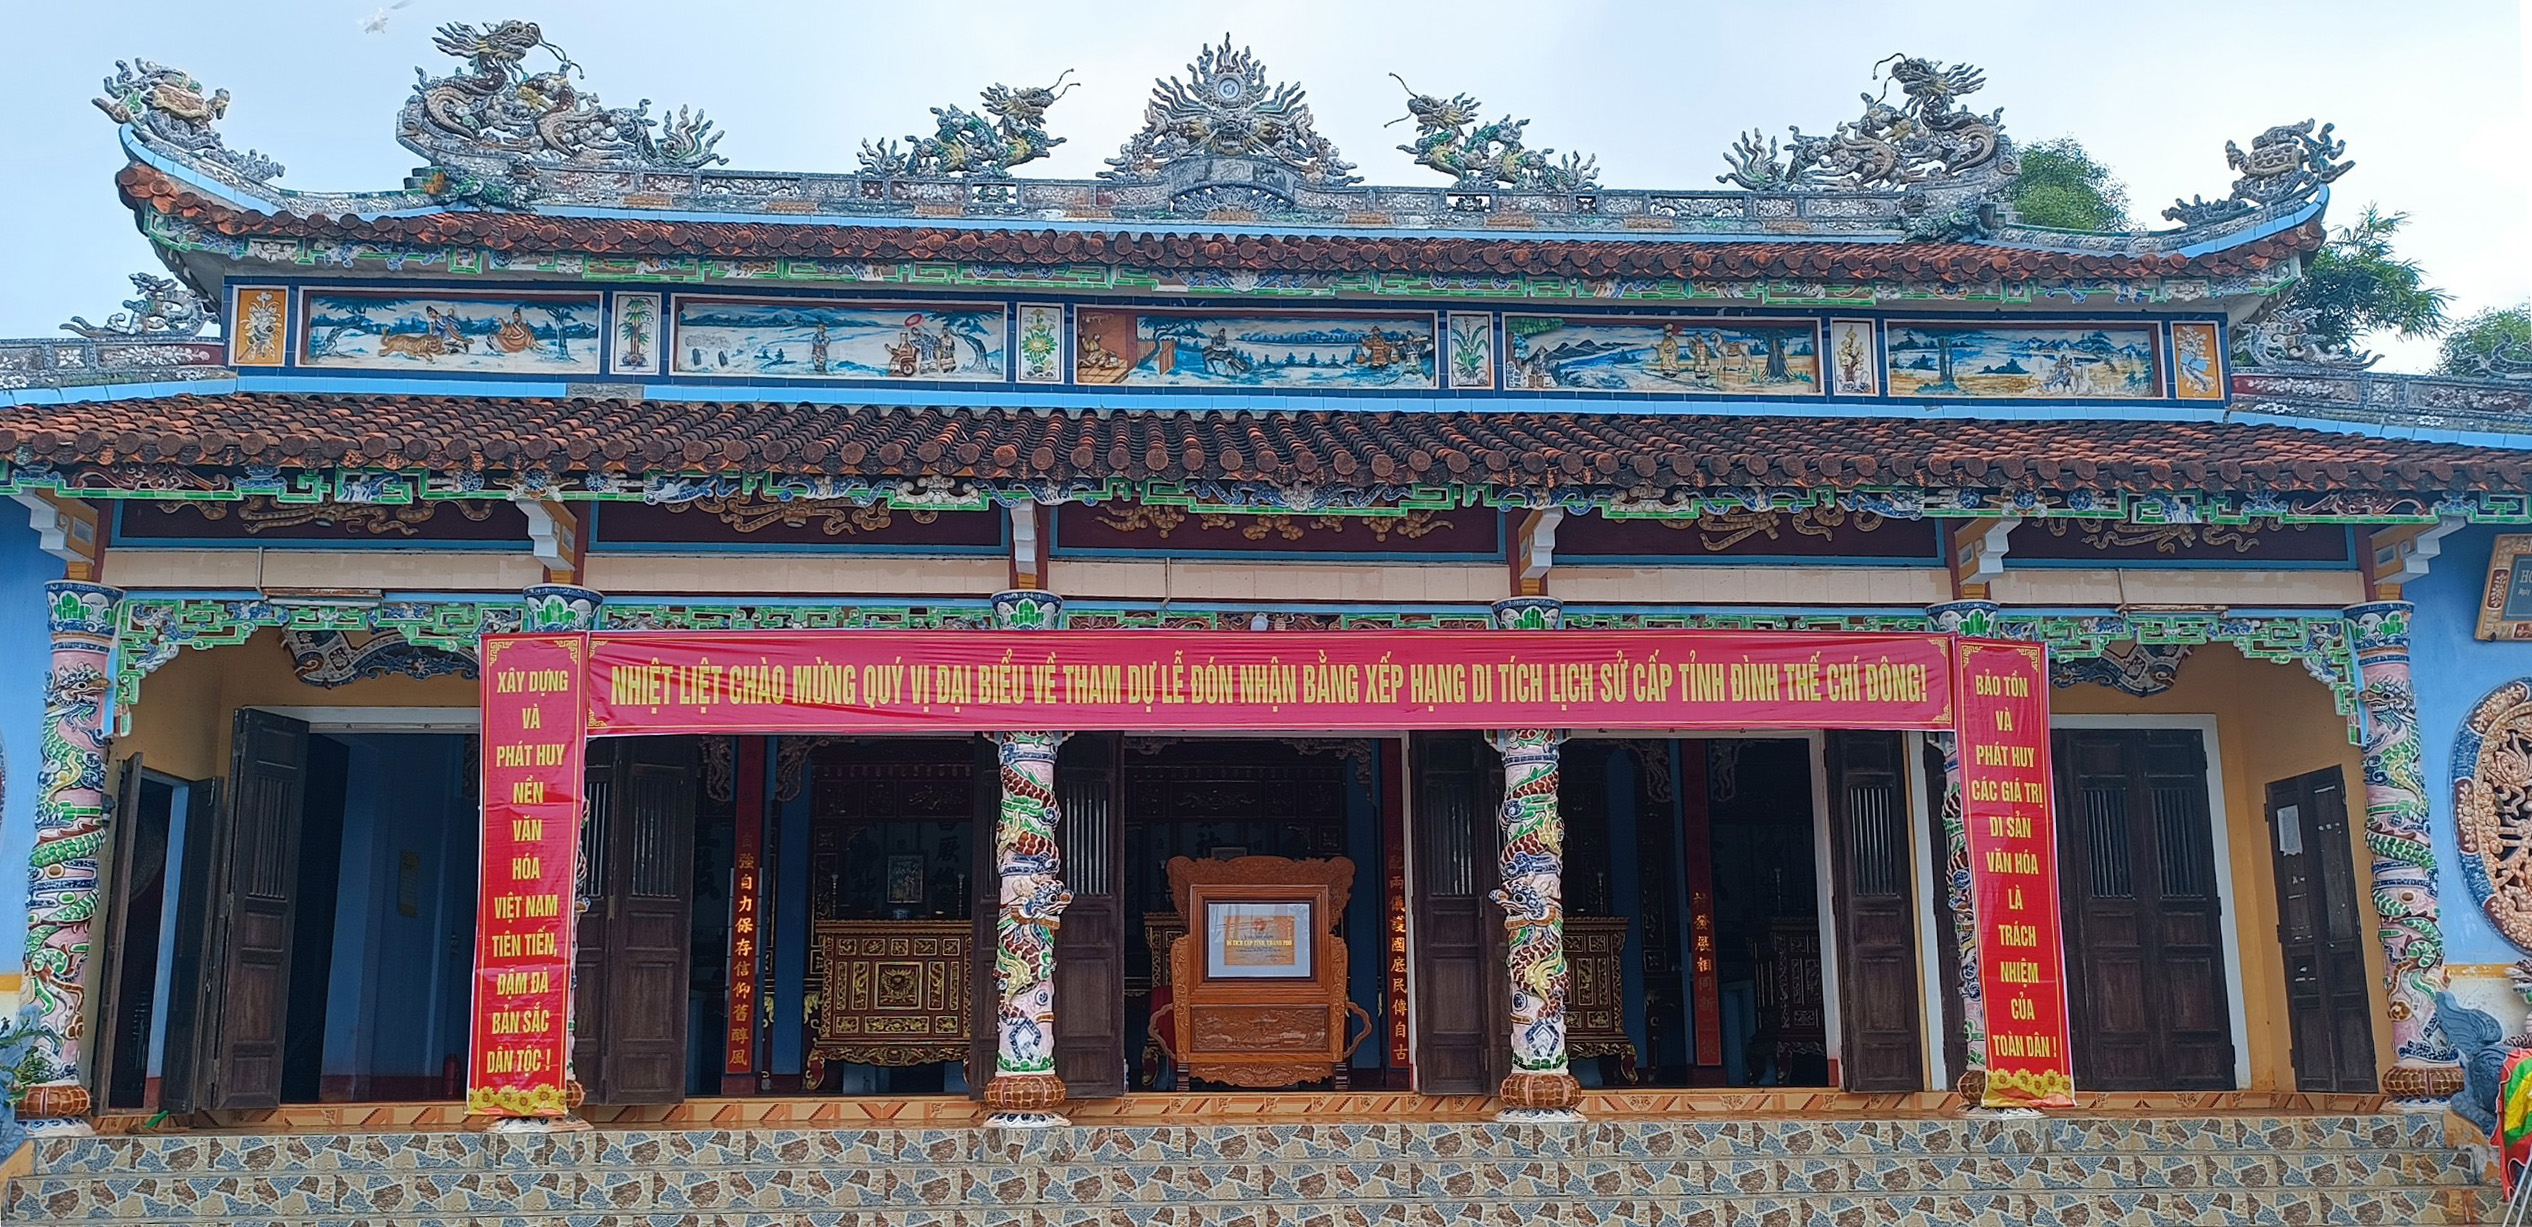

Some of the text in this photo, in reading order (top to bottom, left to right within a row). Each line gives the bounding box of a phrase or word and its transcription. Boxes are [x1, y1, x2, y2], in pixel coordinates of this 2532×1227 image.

[497, 667, 568, 694] XÂY DỰNG
[611, 649, 1927, 713] NHIỆT LIỆT CHÀO MỪNG QUÝ VỊ ĐẠI BIỂU VỀ THAM DỰ LỄ ĐÓN NHẬN BẰNG XẾP HẠNG DI TÍCH LỊCH SỬ CẤP TỈNH ĐÌNH THẾ CHÍ ĐÔNG!
[1975, 669, 2029, 698] BẢO TỒN
[522, 707, 540, 729] VÀ
[1995, 710, 2013, 731] VÀ
[496, 743, 565, 767] PHÁT HUY
[1975, 744, 2035, 768] PHÁT HUY
[513, 776, 543, 804] NỀN
[1971, 778, 2043, 810] CÁC GIÁ TRỊ
[512, 815, 542, 841] VĂN
[1989, 811, 2031, 840] DI SẢN
[512, 854, 540, 880] HÓA
[1986, 849, 2039, 875] VĂN HÓA
[494, 891, 558, 923] VIỆT NAM
[2007, 885, 2023, 910] LÀ
[491, 926, 558, 959] TIÊN TIẾN,
[1997, 921, 2036, 947] TRÁCH
[496, 969, 549, 998] ĐẬM ĐÀ
[2000, 957, 2039, 987] NHIỆM
[491, 1001, 550, 1034] BẢN SẮC
[2010, 992, 2035, 1021] CỦA
[1992, 1031, 2023, 1058] TOÀN
[2025, 1034, 2049, 1059] DÂN
[486, 1047, 513, 1073] DÂN
[515, 1045, 542, 1077] TỘC
